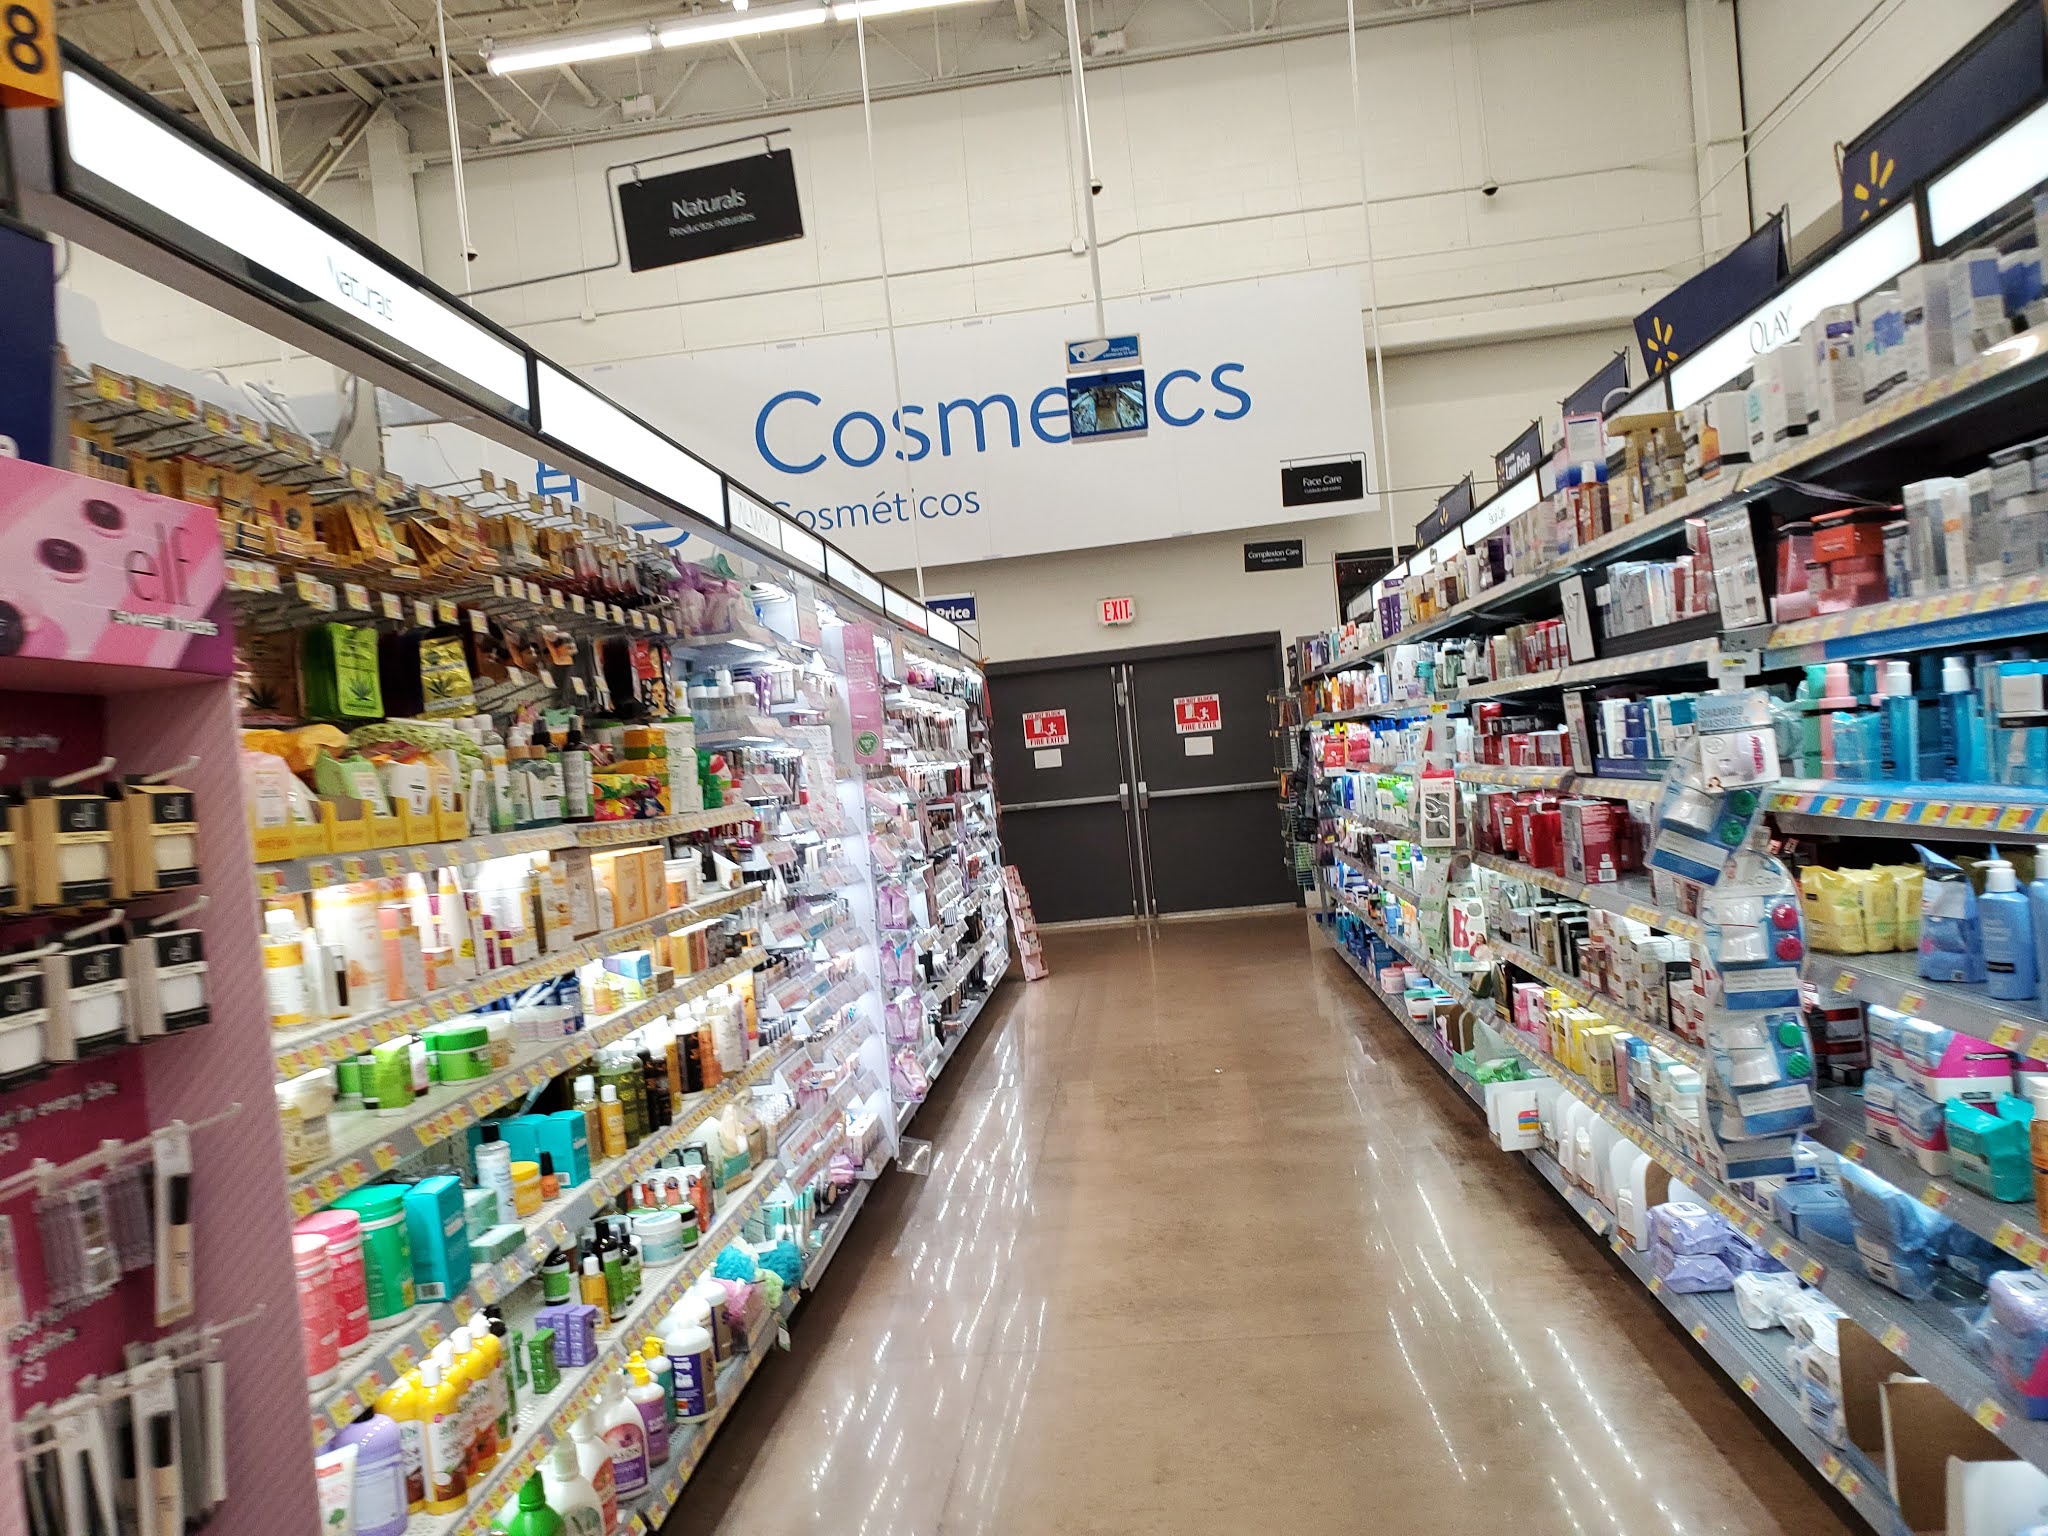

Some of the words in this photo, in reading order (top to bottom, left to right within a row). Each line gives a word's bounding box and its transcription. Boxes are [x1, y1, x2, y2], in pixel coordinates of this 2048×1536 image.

[6, 5, 44, 74] 8
[672, 188, 747, 220] Naturals
[1750, 304, 1792, 354] OLAY
[756, 362, 1252, 474] Cosmecs
[1505, 462, 1517, 480] Low
[1516, 450, 1531, 475] Price
[1302, 477, 1321, 487] Face
[1322, 474, 1342, 485] Care
[1247, 550, 1285, 559] Complexion
[1285, 548, 1300, 556] Care
[1103, 600, 1130, 621] EXIT
[1181, 723, 1195, 731] FIRE
[1197, 721, 1217, 729] EXITS
[1030, 738, 1044, 746] FIRE
[1046, 736, 1065, 744] EXITS
